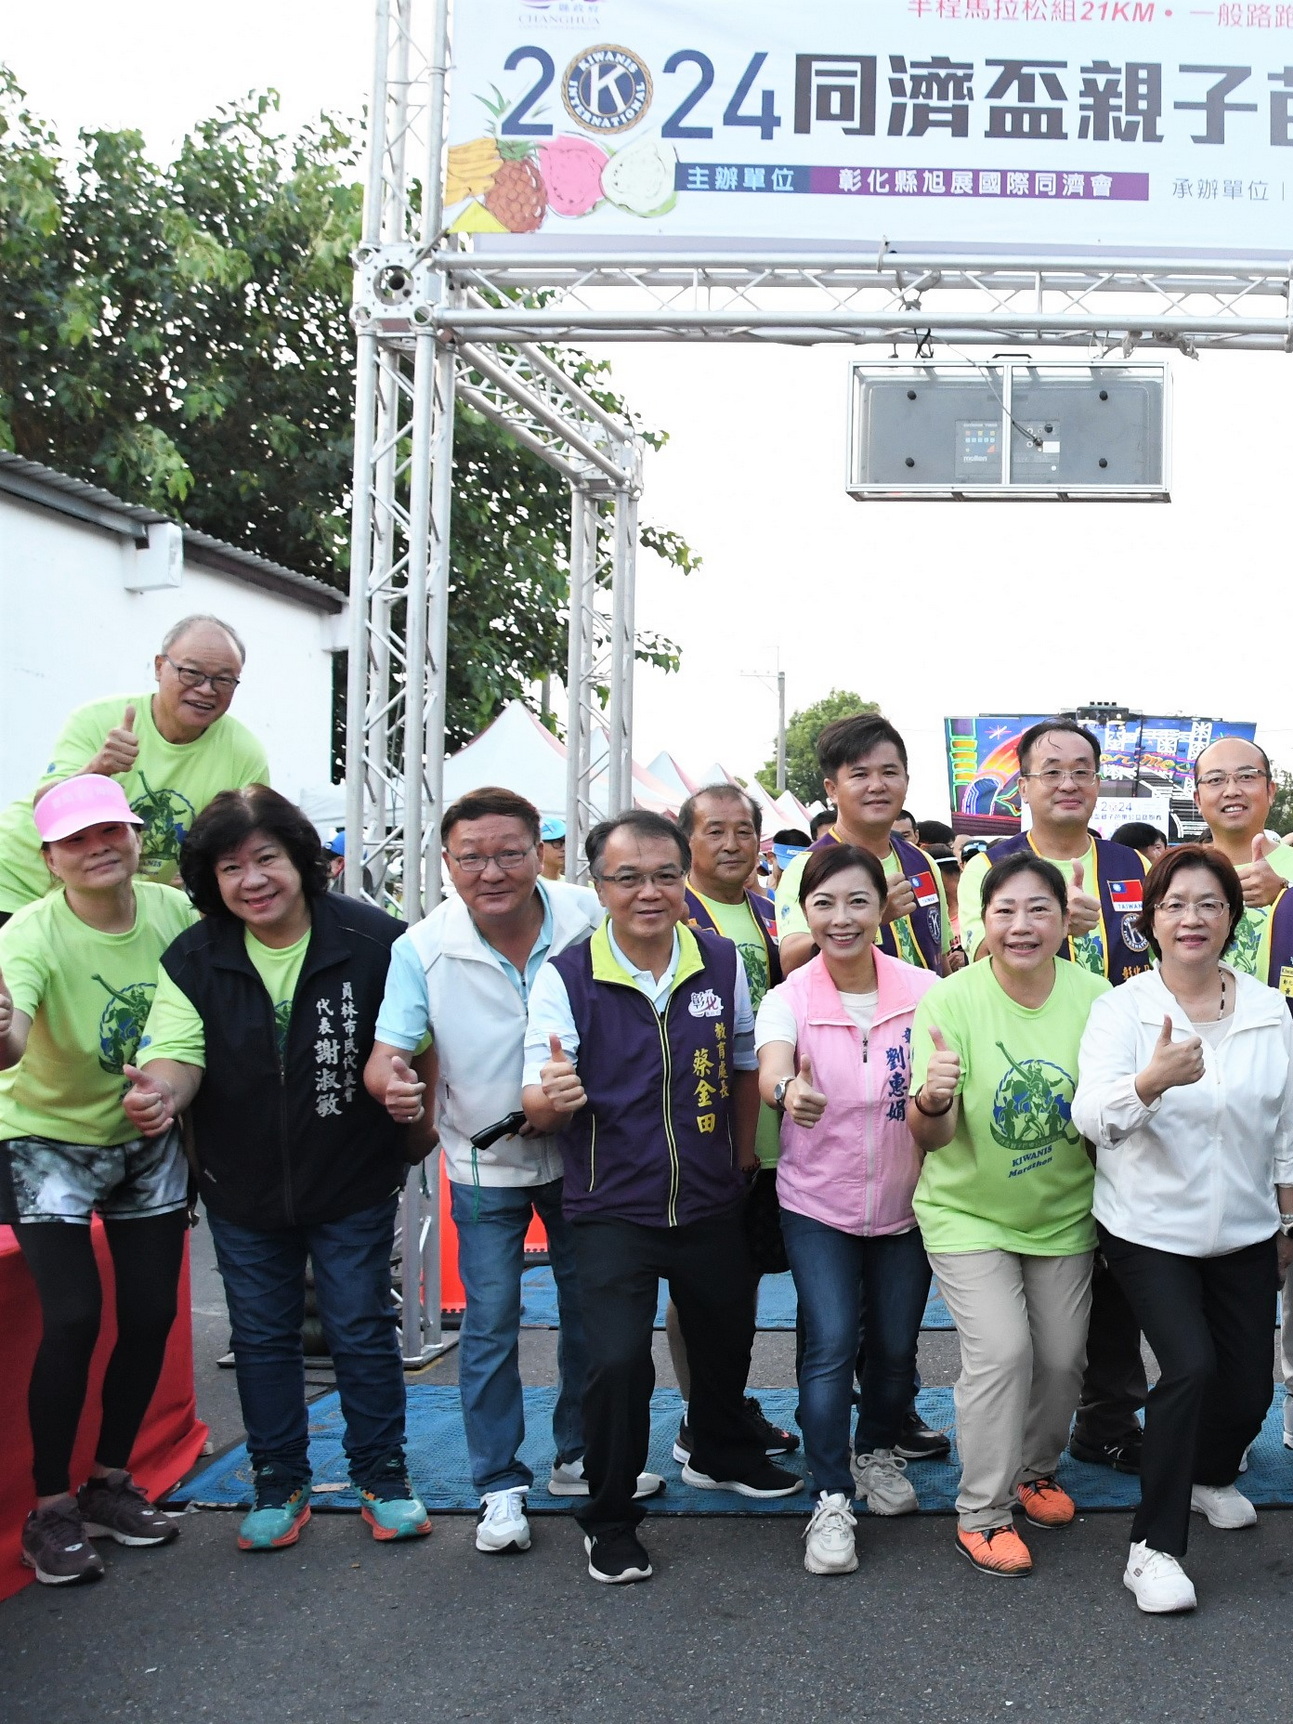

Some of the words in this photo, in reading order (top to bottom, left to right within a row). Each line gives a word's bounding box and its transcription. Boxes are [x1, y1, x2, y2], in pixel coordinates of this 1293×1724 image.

[578, 51, 638, 73] KIWANIS
[567, 80, 647, 128] INTERNATIONAL
[686, 166, 795, 191] 主辦單位
[838, 168, 1114, 198] 彰化縣旭展國際同濟會
[341, 981, 359, 1103] 員林市民代表會
[714, 1021, 730, 1099] 教育處長
[692, 1047, 717, 1134] 蔡金田
[1007, 1156, 1053, 1179] Marathon
[1012, 1144, 1053, 1168] KIWANIS
